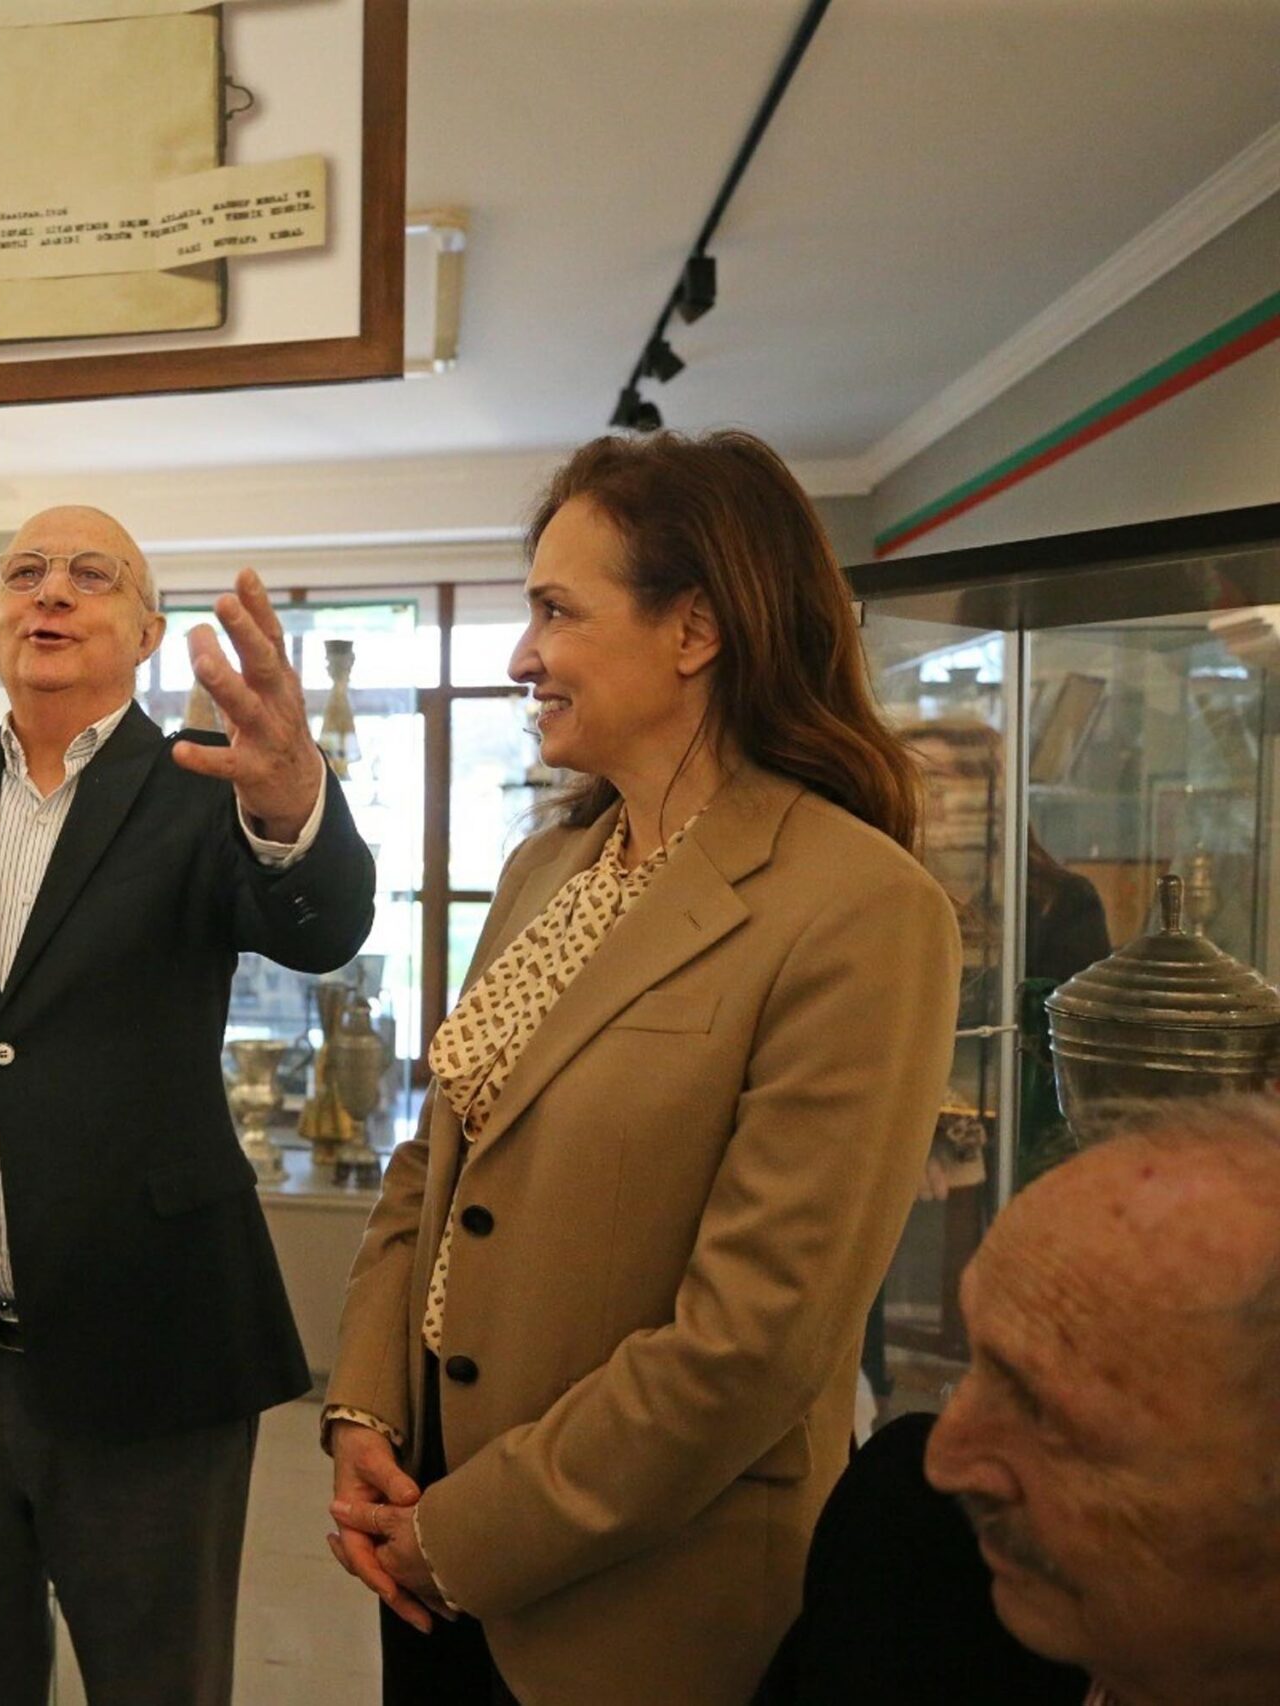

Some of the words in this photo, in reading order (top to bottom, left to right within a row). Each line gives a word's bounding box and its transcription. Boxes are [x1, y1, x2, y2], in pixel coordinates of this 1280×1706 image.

[296, 190, 310, 198] VE
[214, 235, 257, 247] MUSTAFA
[270, 228, 304, 240] KEMAL
